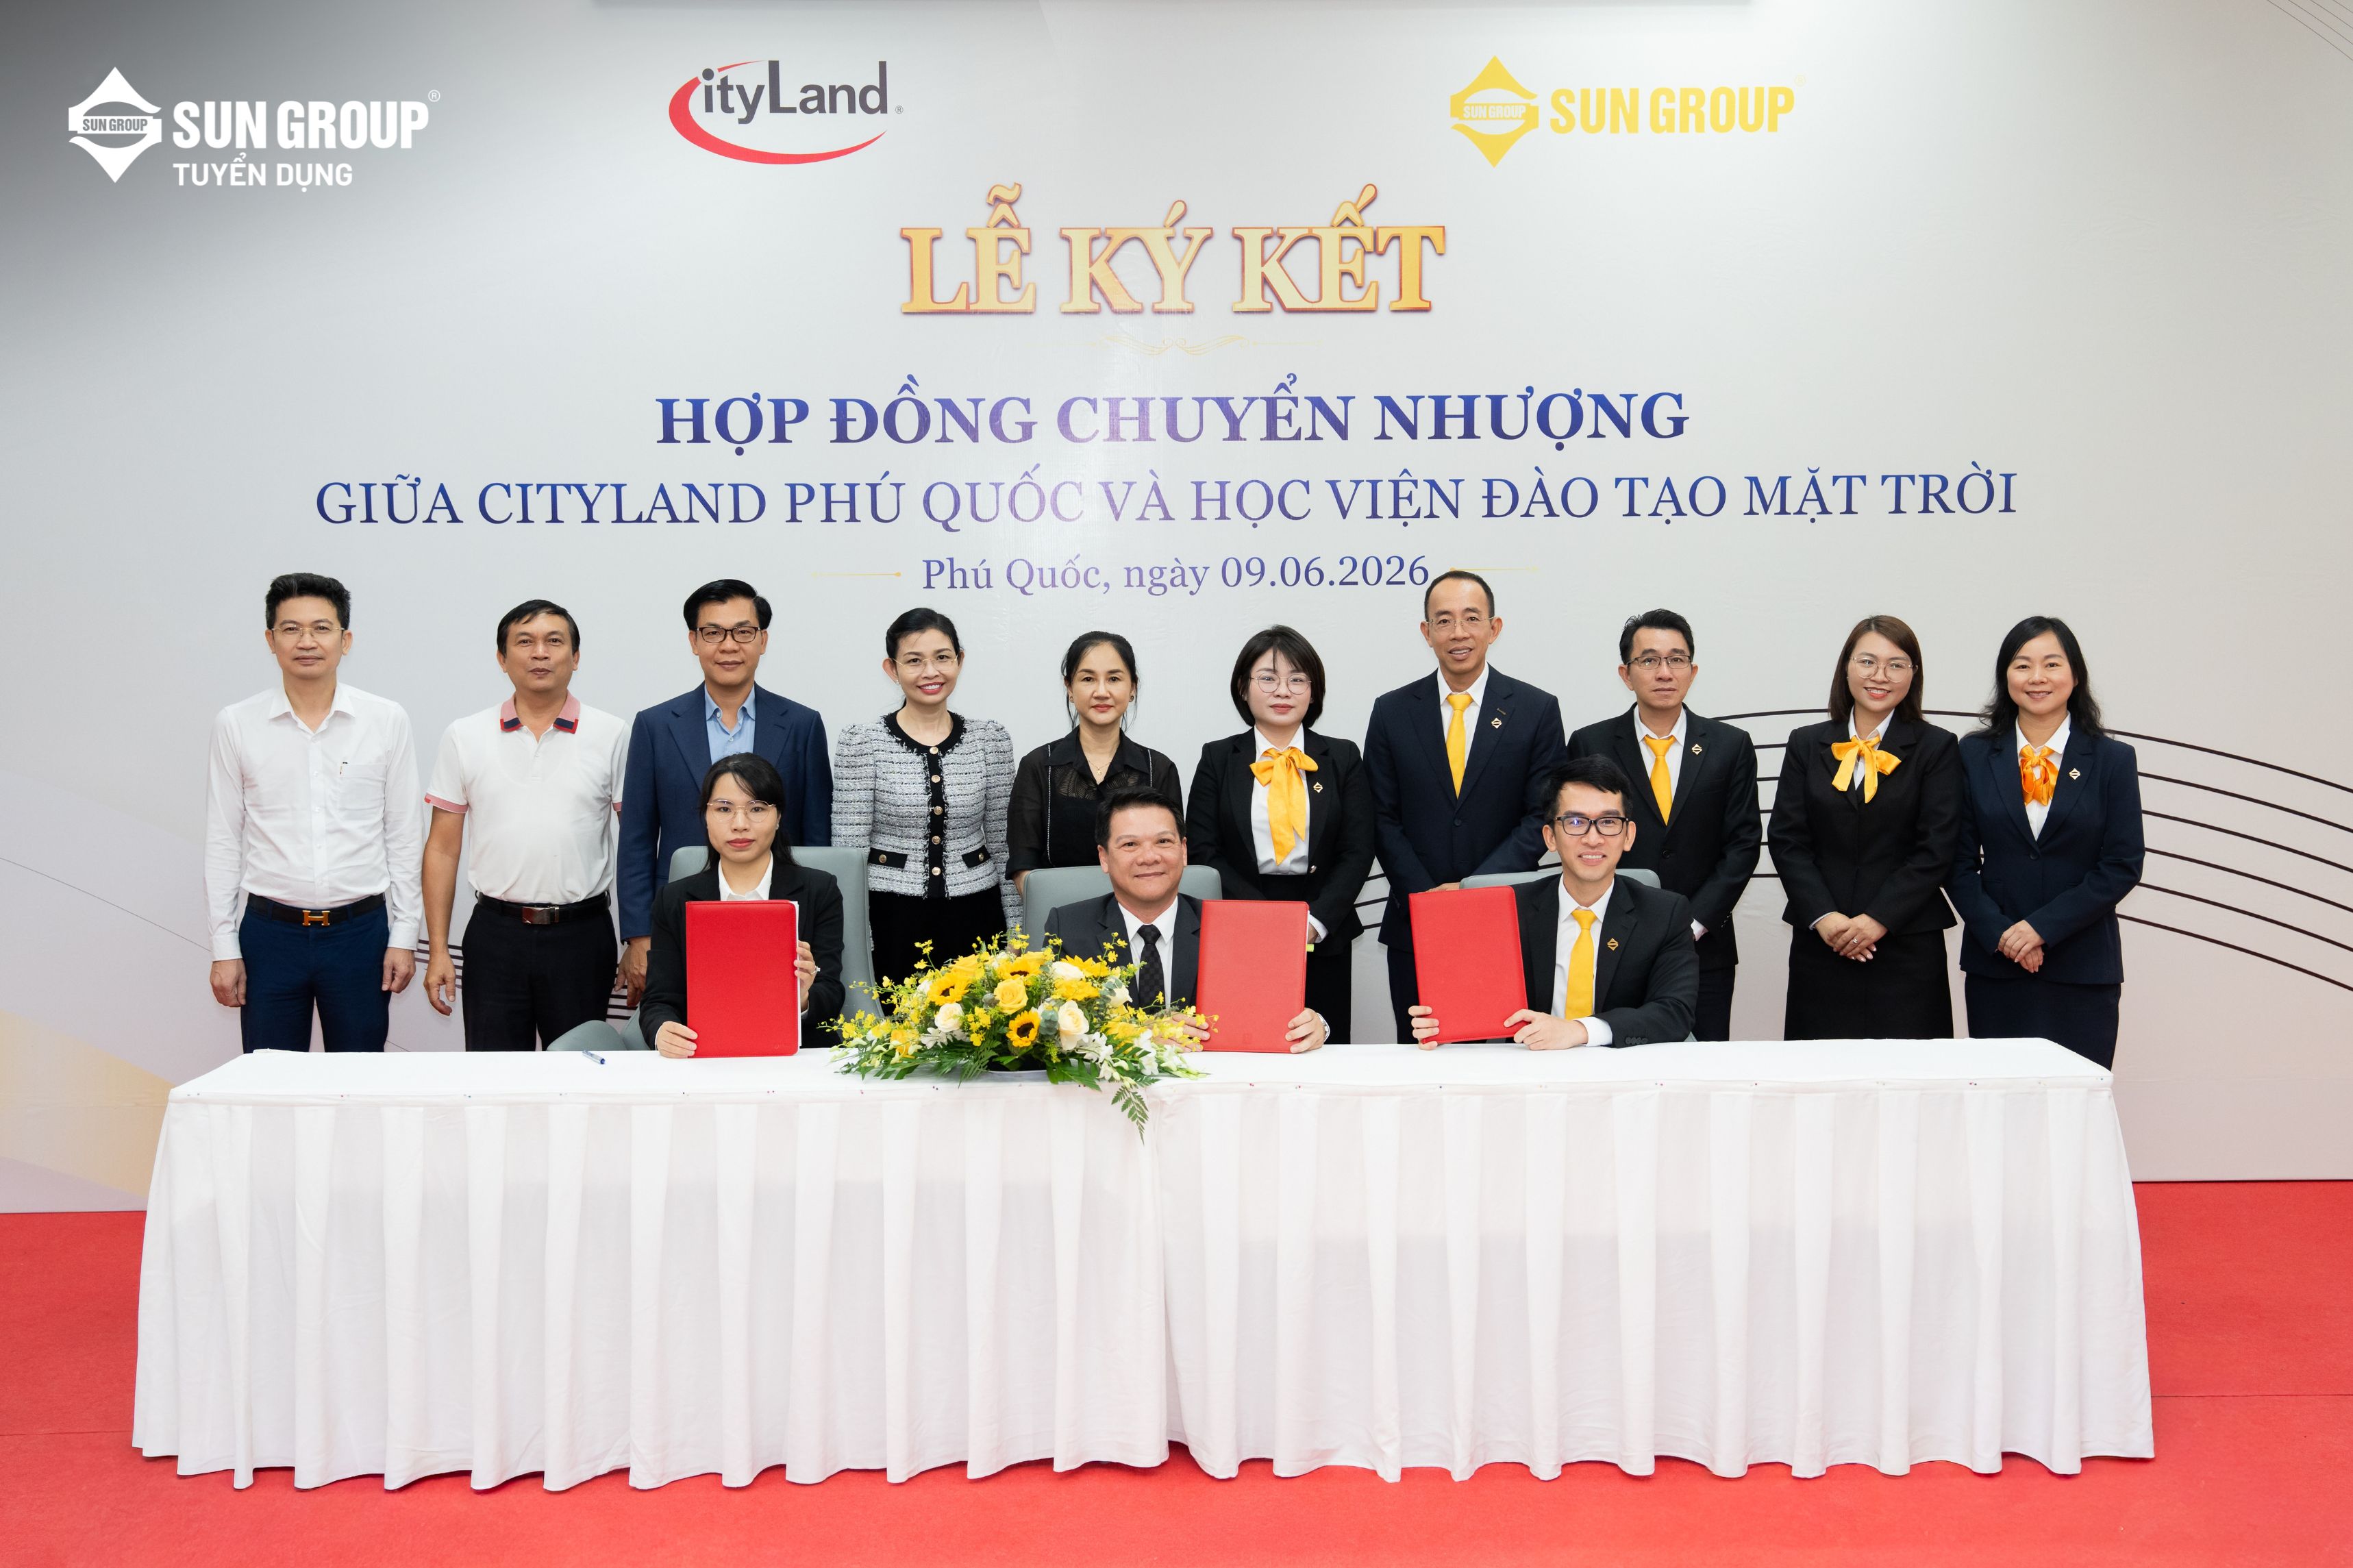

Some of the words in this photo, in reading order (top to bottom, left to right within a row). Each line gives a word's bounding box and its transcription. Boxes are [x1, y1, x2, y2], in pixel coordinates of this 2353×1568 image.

[1463, 105, 1486, 119] SUN
[1489, 105, 1526, 119] GROUP
[1549, 87, 1639, 135] SUN
[1649, 86, 1795, 135] GROUP
[899, 182, 1036, 313] LỄ
[1059, 199, 1214, 313] KÝ
[1231, 183, 1446, 313] KẾT
[656, 392, 810, 456] HỢP
[829, 374, 1038, 445] ĐỒNG
[1056, 373, 1356, 444] CHUYỂN
[1373, 385, 1689, 451] NHƯỢNG
[316, 473, 463, 525] GIỮA
[478, 482, 767, 525] CITYLAND
[785, 471, 907, 524] PHÚ
[922, 463, 1086, 532] QUỐC
[1099, 469, 1175, 521] VÀ
[1191, 480, 1311, 529] HỌC
[1325, 469, 1466, 527] VIỆN
[1482, 466, 1599, 519] ĐÀO
[1614, 475, 1727, 525] TẠO
[1743, 467, 1867, 523] MẶT
[1880, 461, 2017, 514] TRỜI
[922, 557, 992, 590] Phú
[1006, 556, 1110, 595] Quốc,
[1123, 559, 1210, 595] ngày
[1221, 555, 1429, 587] 09.06.2026
